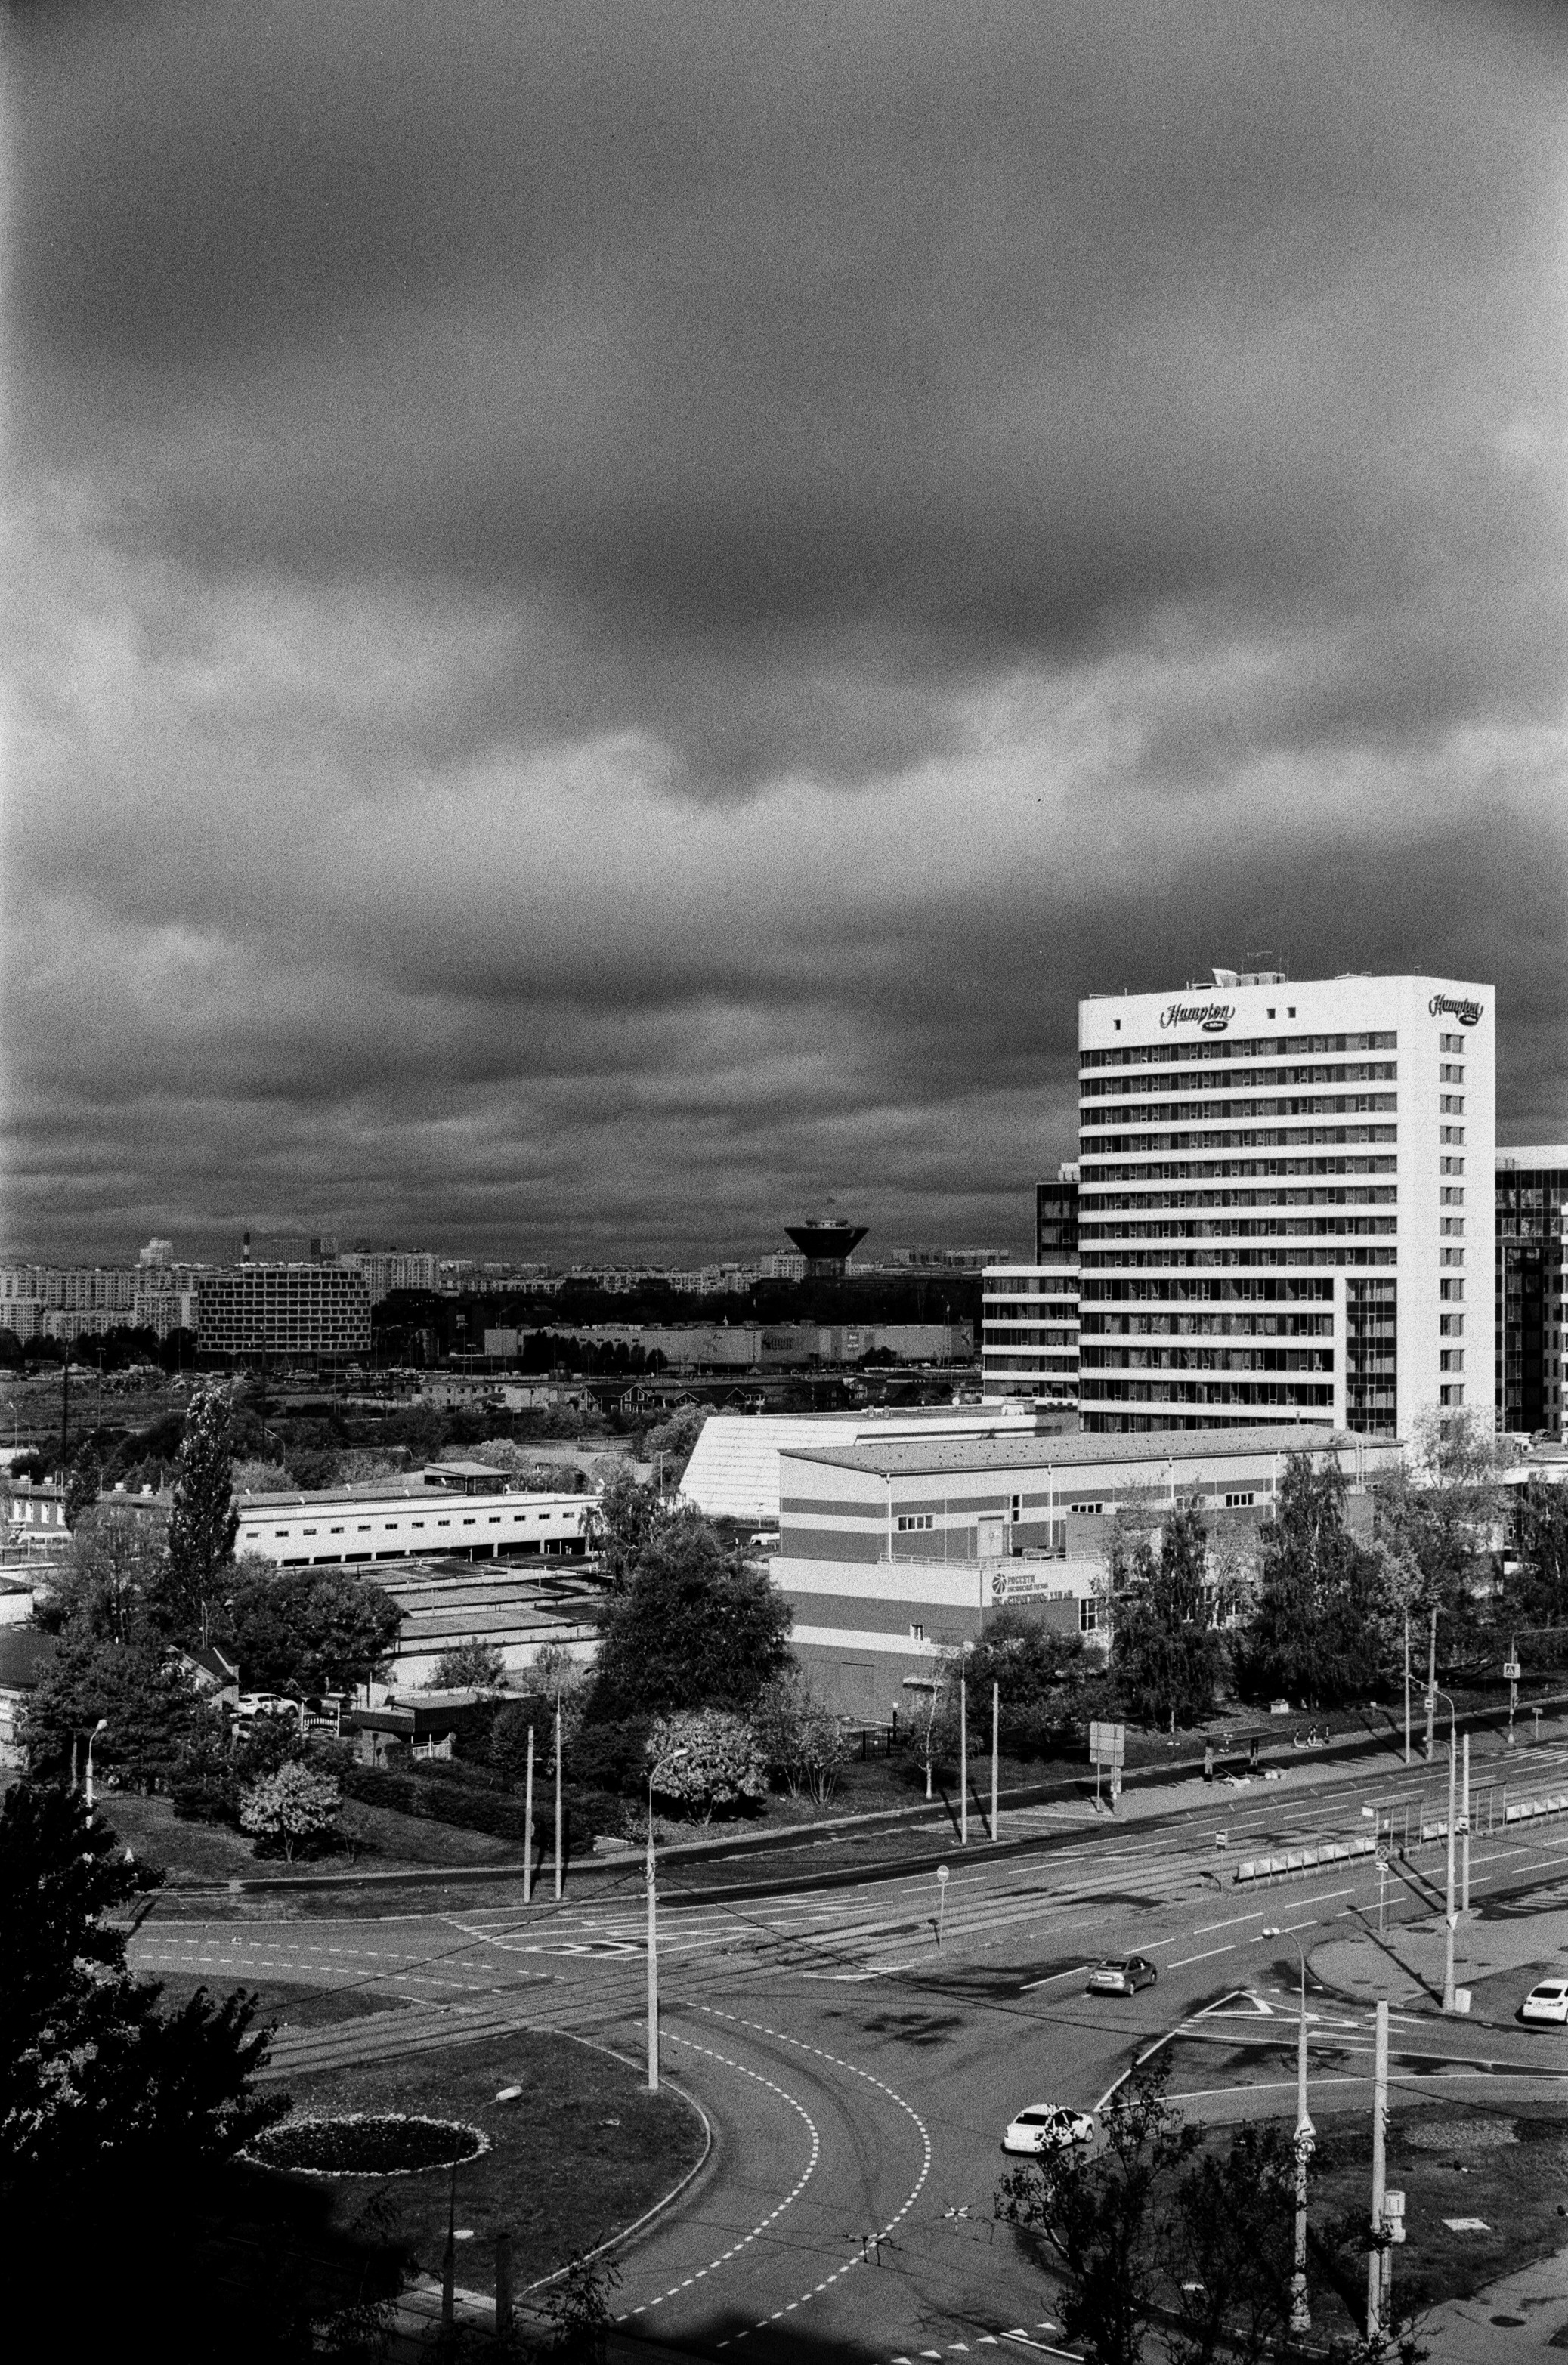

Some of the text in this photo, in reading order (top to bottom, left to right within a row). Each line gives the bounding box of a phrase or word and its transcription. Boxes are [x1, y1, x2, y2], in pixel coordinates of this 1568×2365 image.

[1159, 1003, 1236, 1029] Hampton
[1428, 994, 1484, 1018] Hampton
[1007, 1575, 1035, 1584] РОССЕТИ
